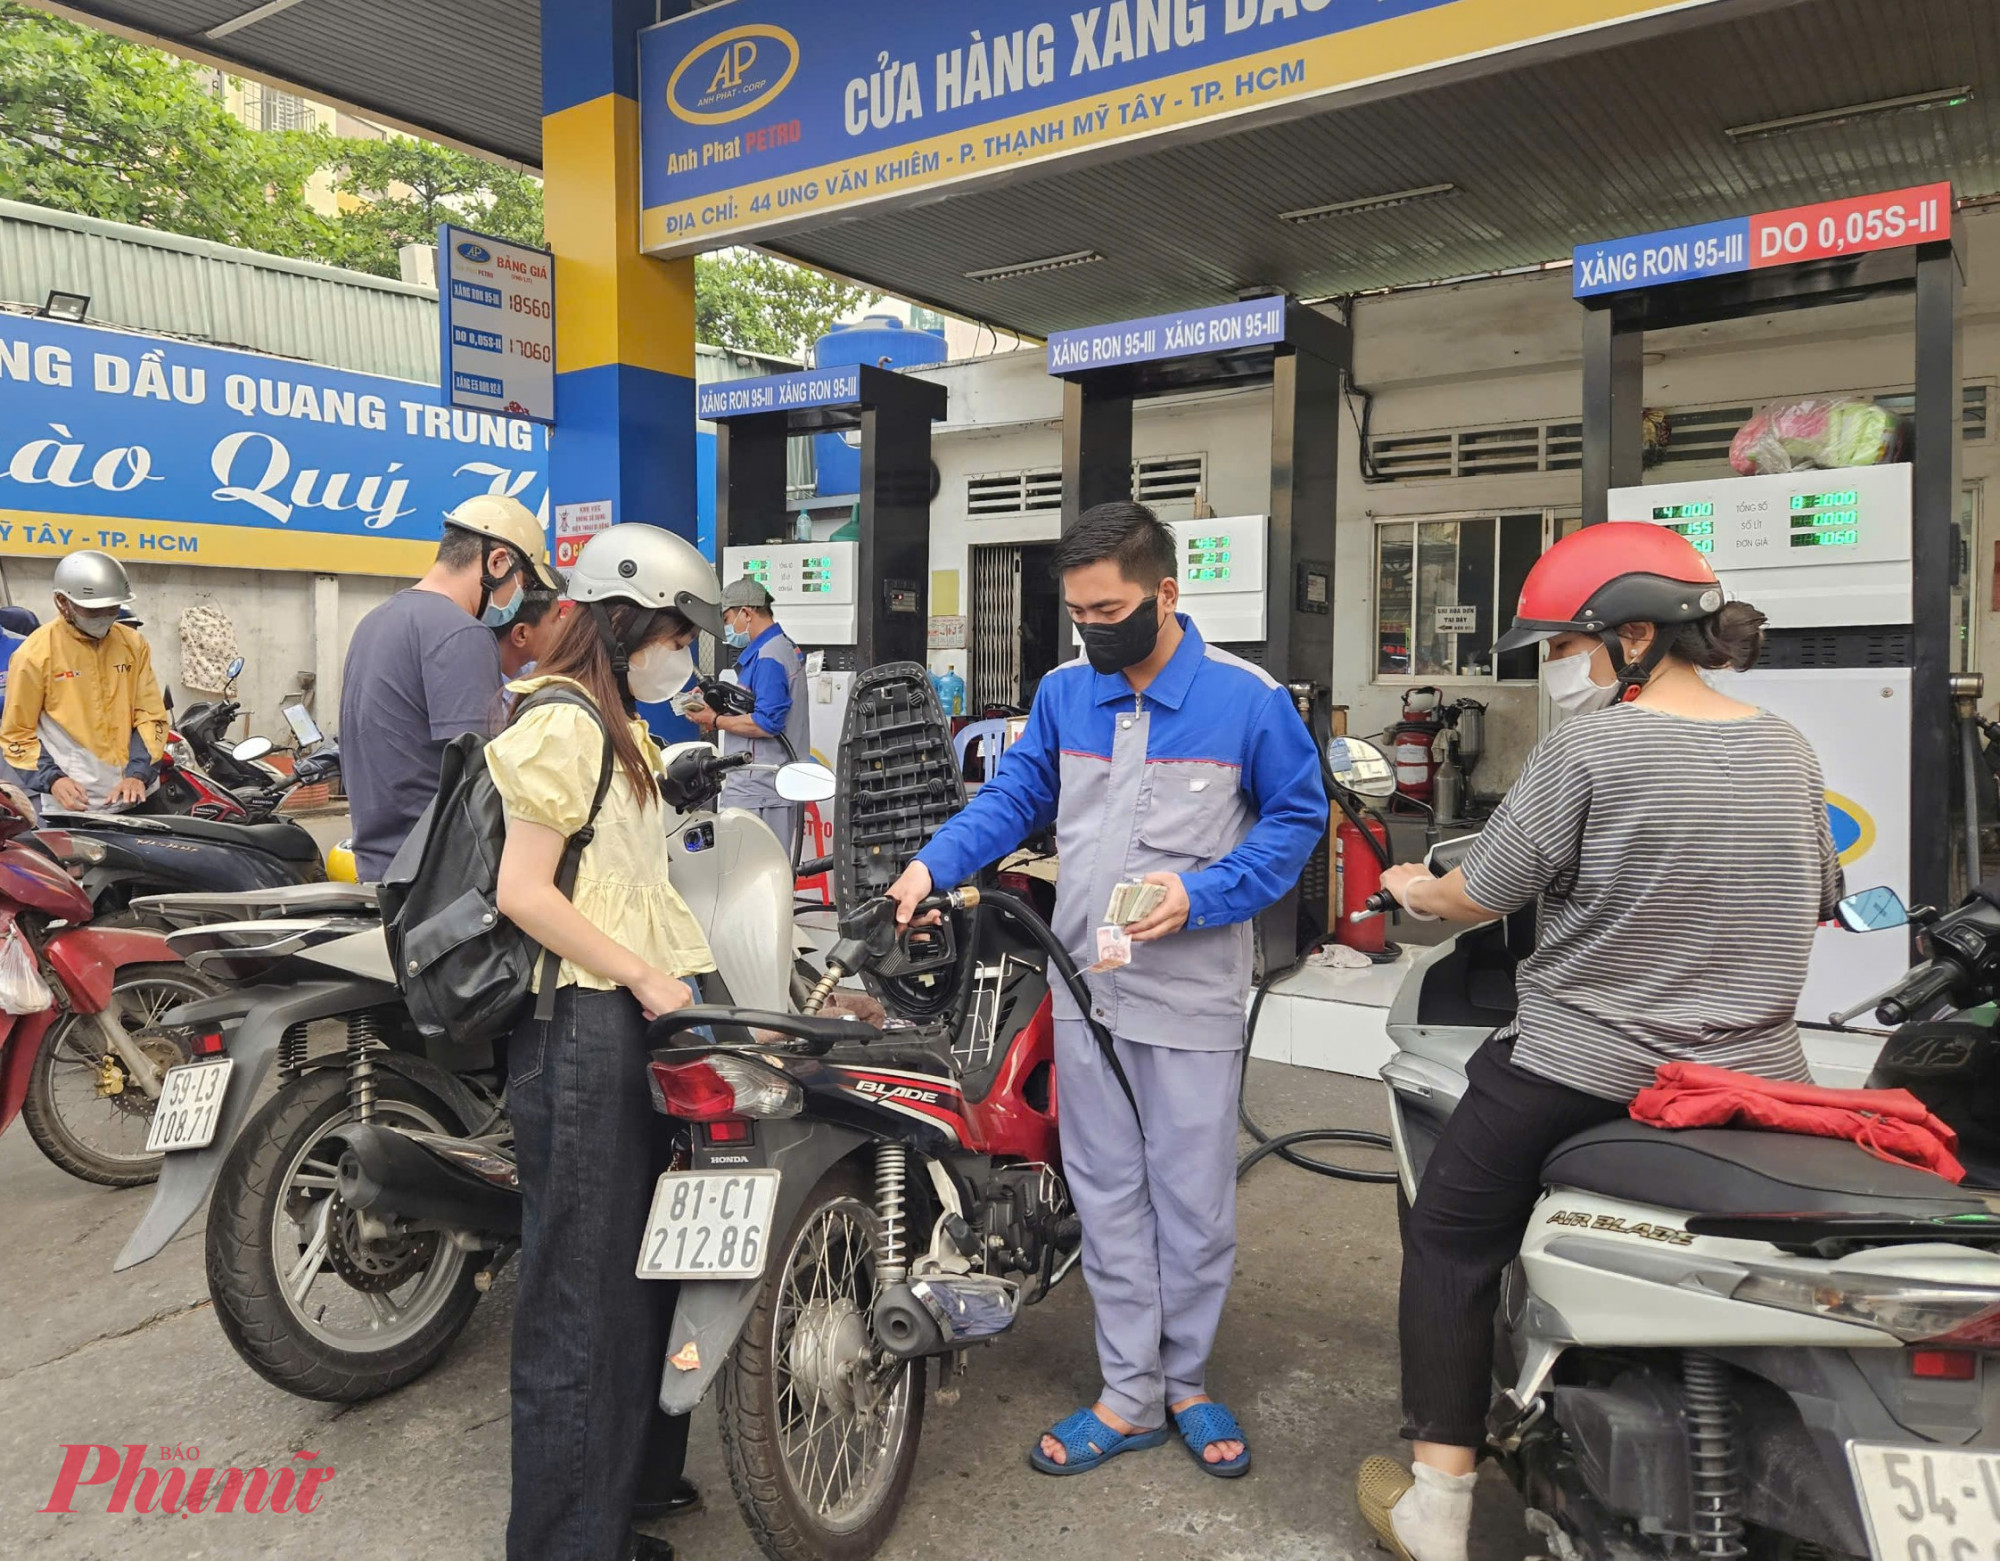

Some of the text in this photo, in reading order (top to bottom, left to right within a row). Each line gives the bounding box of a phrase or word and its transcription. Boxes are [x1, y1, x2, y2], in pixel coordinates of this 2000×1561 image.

[706, 40, 757, 94] AP
[845, 50, 922, 136] CỬA
[936, 22, 1055, 113] HÀNG
[697, 96, 714, 107] ANH
[716, 89, 736, 102] PHAT
[743, 80, 766, 94] CORP
[666, 212, 696, 236] ĐỊA
[702, 195, 738, 224] CHỈ:
[750, 195, 771, 213] 44
[777, 182, 818, 207] UNG
[825, 169, 868, 196] VĂN
[875, 151, 940, 184] KHIÊM
[960, 143, 976, 164] P.
[984, 120, 1064, 156] THẠNH
[1073, 104, 1110, 137] MỸ
[1117, 94, 1166, 126] TÂY
[1190, 80, 1224, 108] TP.
[1235, 58, 1305, 97] HCM
[667, 119, 802, 176] Anh Phat PETRO
[1760, 200, 1937, 258] DO 0,05S-II
[496, 255, 527, 274] BẢNG
[530, 264, 548, 280] GIÁ
[1580, 233, 1743, 288] XĂNG RON 95-III
[509, 294, 551, 320] 18560
[455, 330, 467, 342] DO
[509, 338, 551, 364] 17060
[1052, 310, 1280, 367] XĂNG RON 95-III XĂNG RON 95-III
[94, 349, 206, 404] DẦU
[225, 374, 387, 431] QUANG
[400, 401, 533, 451] TRUNG
[701, 376, 856, 414] XĂNG RON 95-III XĂNG RON 95-III
[211, 431, 416, 529] Quý
[1736, 501, 1768, 514] TỔNG SỐ
[1741, 520, 1752, 530] SỐ
[23, 522, 74, 546] TÂY
[98, 530, 130, 548] TP.
[139, 534, 198, 552] HCM
[1736, 538, 1768, 548] ĐƠN GIÁ
[170, 1067, 220, 1106] 59-L3
[856, 1080, 939, 1104] BLADE
[155, 1105, 214, 1146] 108.71
[710, 1156, 748, 1164] HONDA
[670, 1178, 756, 1221] 81-C1
[1546, 1210, 1700, 1246] AIR BLADE
[650, 1225, 761, 1270] 212.86
